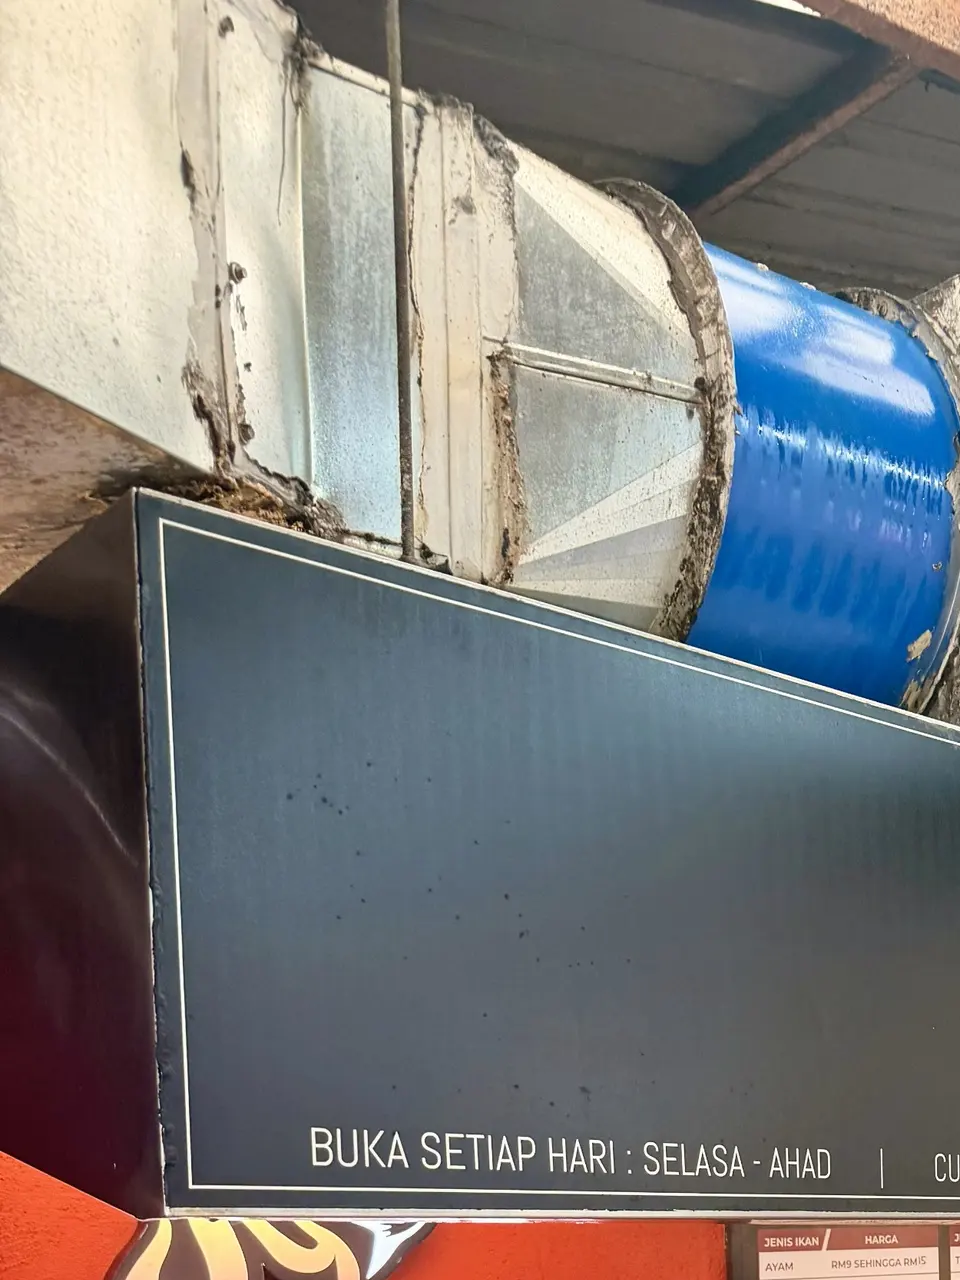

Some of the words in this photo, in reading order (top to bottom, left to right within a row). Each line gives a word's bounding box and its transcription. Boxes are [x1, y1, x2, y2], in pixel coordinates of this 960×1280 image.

[310, 1127, 409, 1168] BUKA
[420, 1131, 536, 1172] SETIAP
[548, 1137, 615, 1174] HARI
[643, 1141, 745, 1178] SELASA
[769, 1147, 831, 1179] AHAD
[764, 1237, 793, 1248] JENIS
[795, 1237, 819, 1247] IKAN
[864, 1234, 899, 1245] HARGA
[765, 1262, 794, 1272] AYAM
[831, 1260, 852, 1269] RM9
[854, 1258, 902, 1268] SEHINGGA
[903, 1256, 927, 1266] RM15
